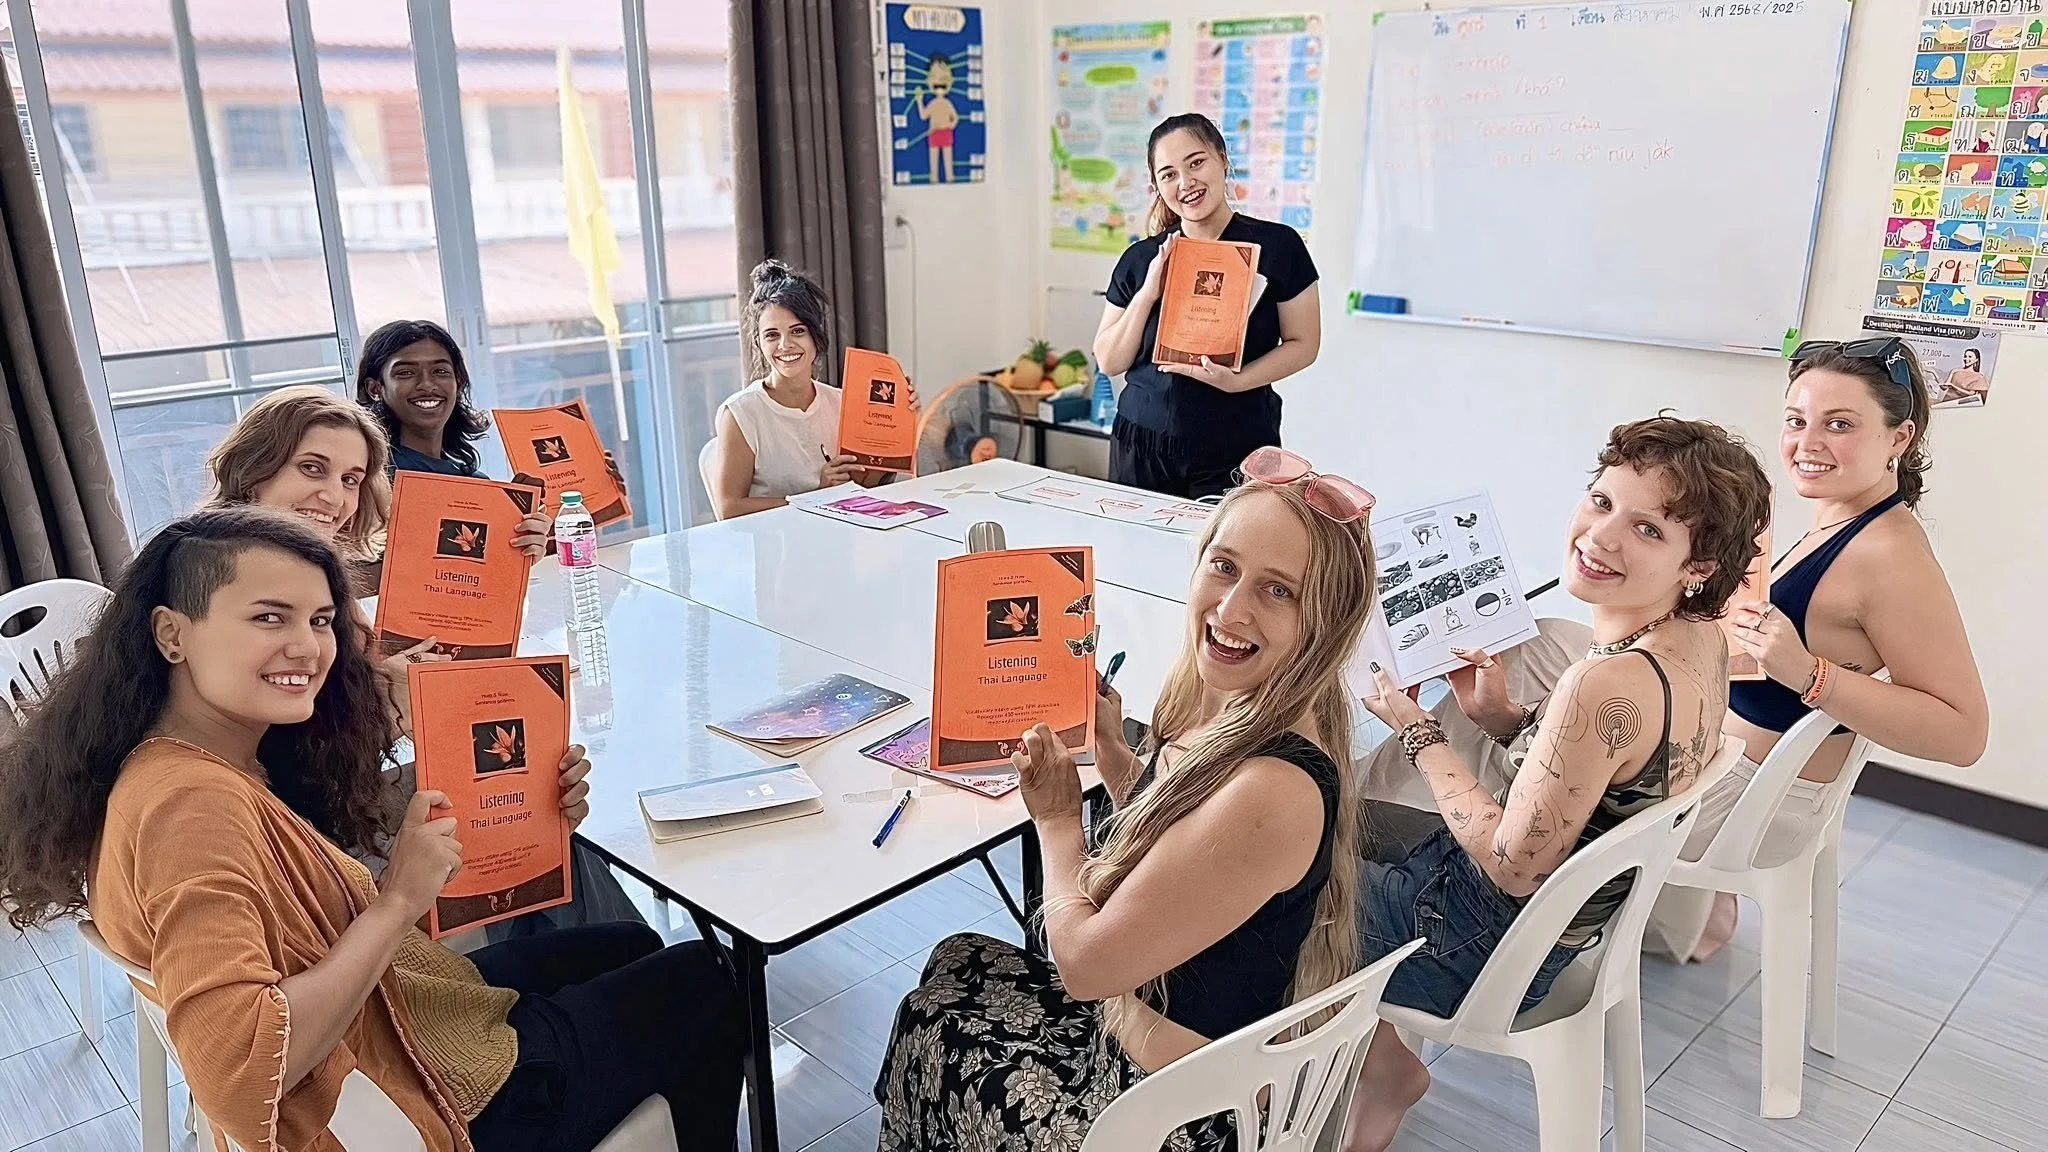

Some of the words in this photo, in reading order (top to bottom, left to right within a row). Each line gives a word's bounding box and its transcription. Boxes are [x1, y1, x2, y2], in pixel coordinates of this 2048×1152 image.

[1923, 37, 1933, 49] ก
[1968, 70, 1976, 82] ง
[2020, 69, 2029, 81] จ
[1943, 199, 1955, 216] ป
[1987, 239, 1998, 251] ม
[1975, 304, 1985, 315] อ
[1905, 324, 1931, 332] Thailand
[1933, 326, 1946, 334] Visa
[545, 470, 577, 481] Listening
[435, 568, 480, 587] Listening
[424, 584, 443, 593] Thai
[446, 586, 487, 599] Language
[988, 654, 1037, 669] Listening
[978, 676, 998, 685] Thai
[1001, 673, 1048, 684] Language
[479, 790, 524, 810] Listening
[470, 818, 490, 829] Thai
[493, 810, 532, 826] Language
